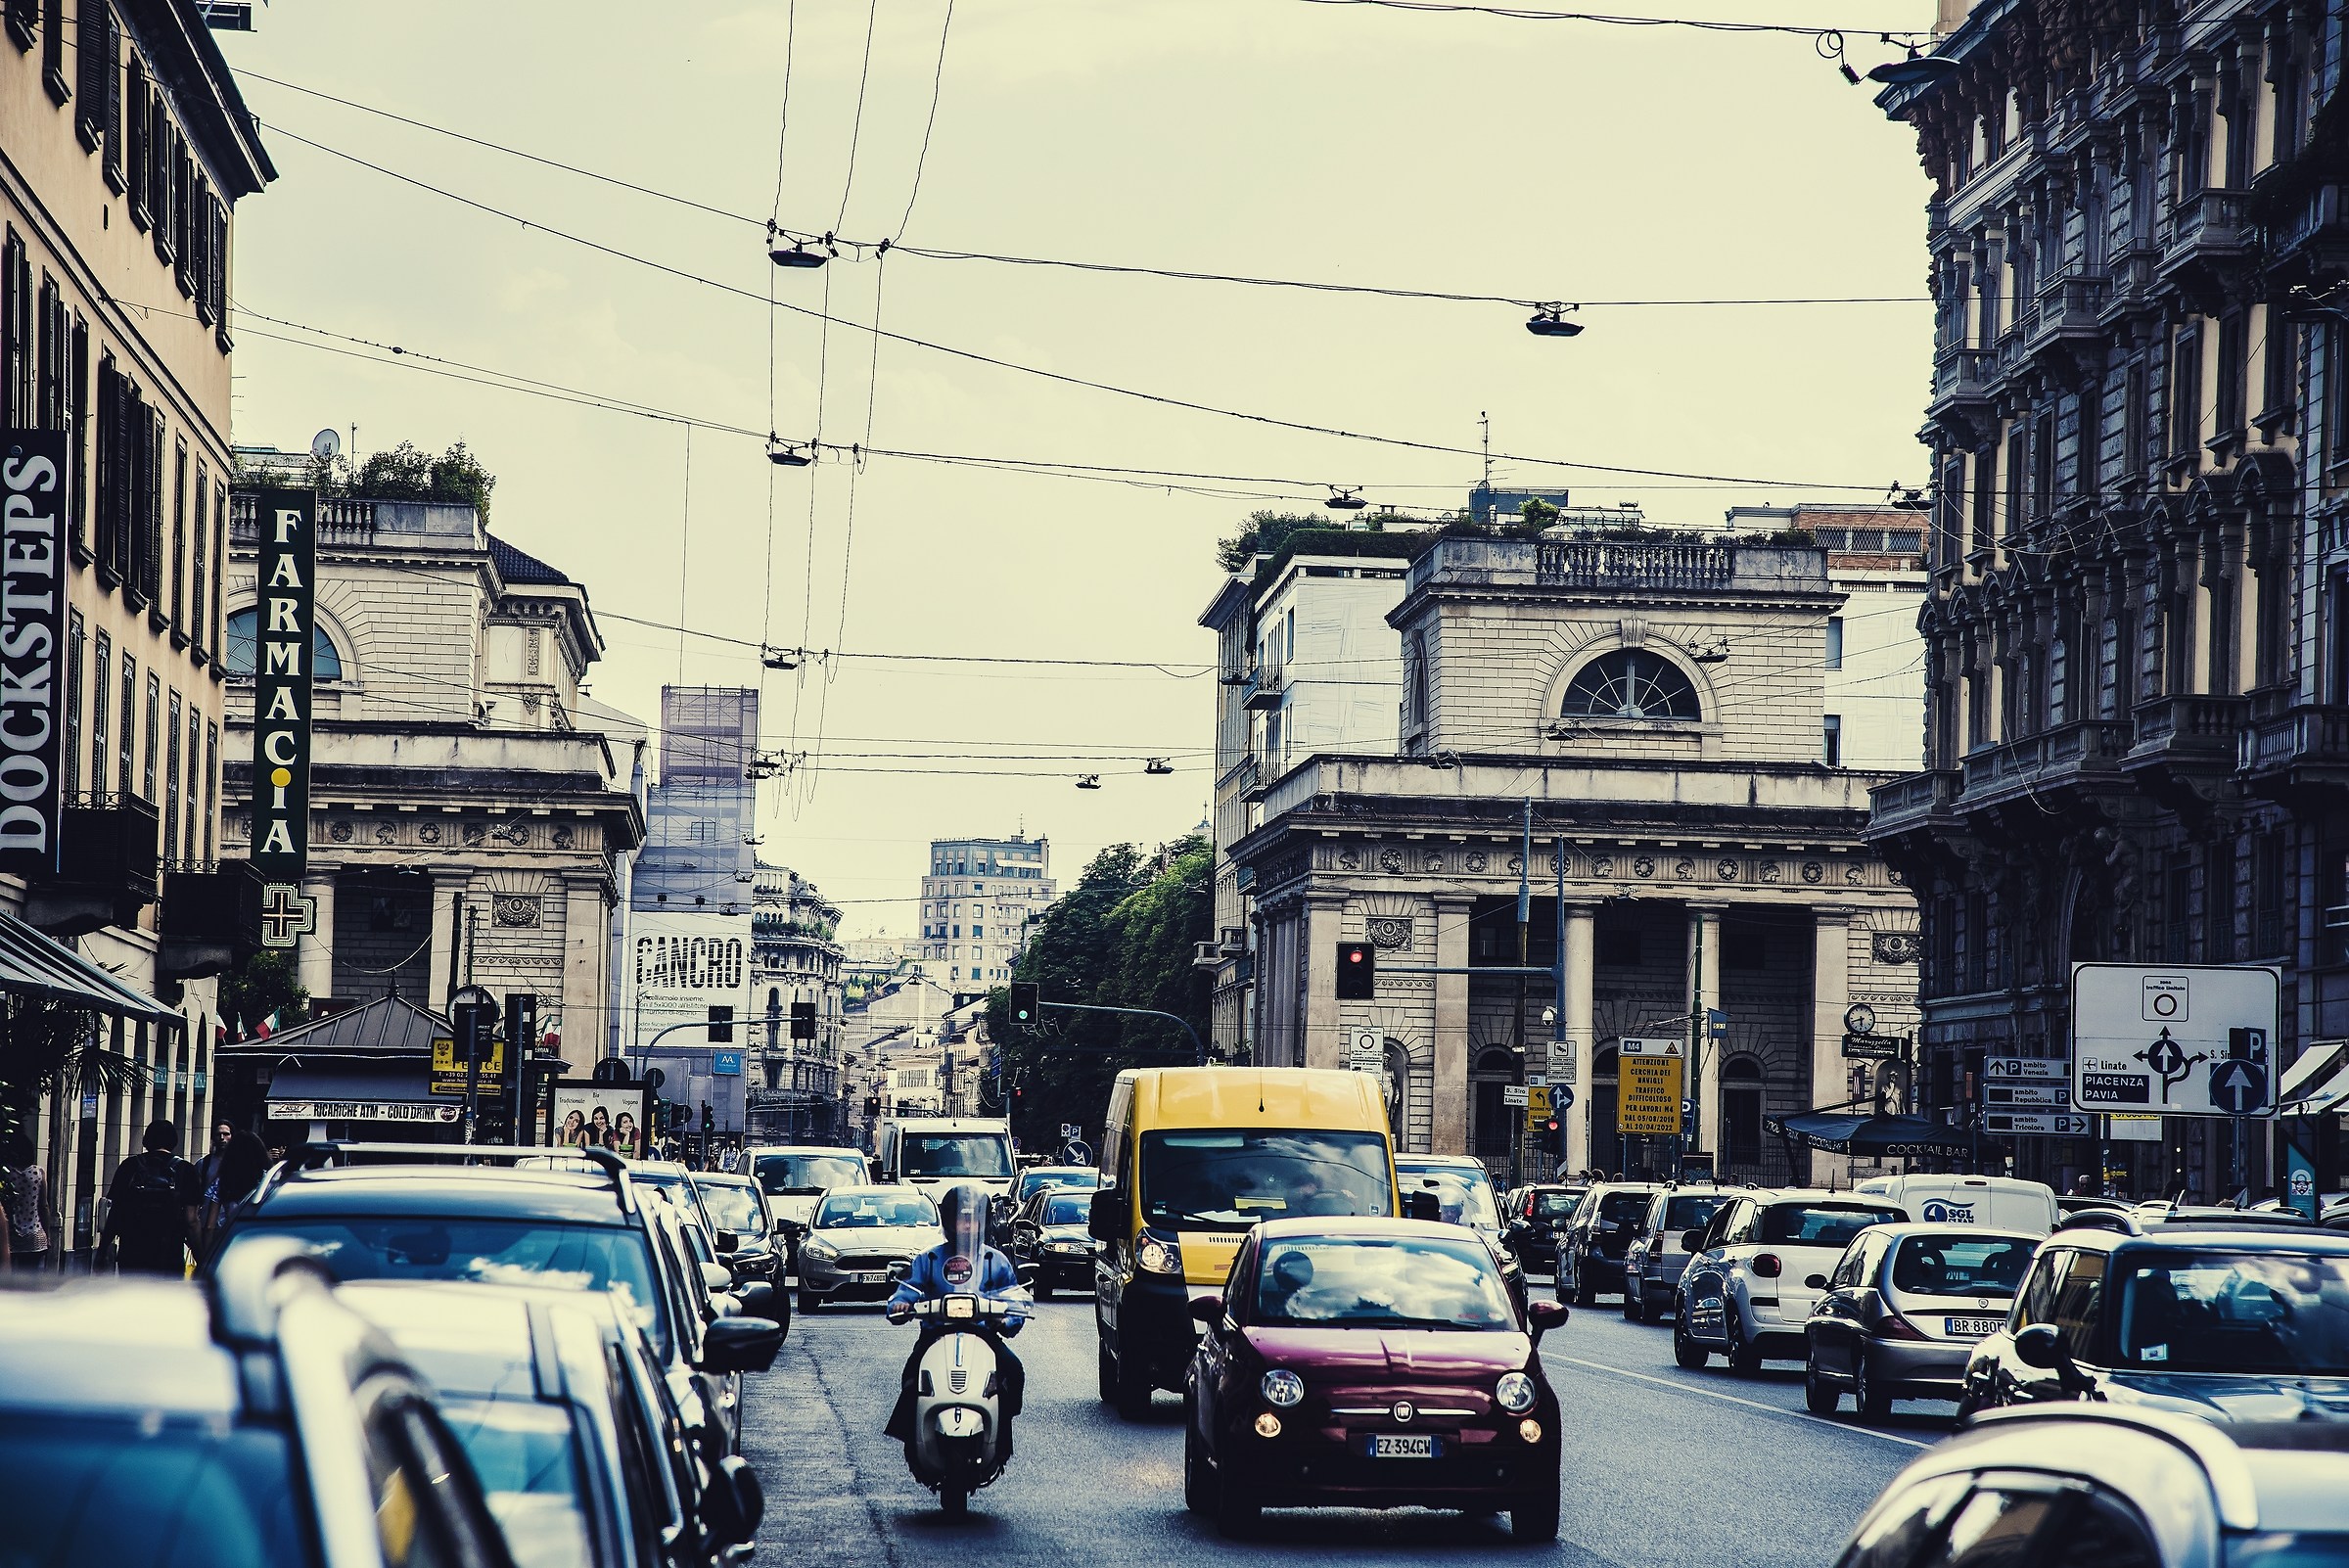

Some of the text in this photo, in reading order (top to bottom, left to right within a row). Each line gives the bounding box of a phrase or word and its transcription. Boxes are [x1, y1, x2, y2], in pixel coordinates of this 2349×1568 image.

[0, 455, 57, 854] DOCKSTEPS
[636, 937, 742, 989] CANCRO
[1627, 1042, 1640, 1051] M4
[1851, 1038, 1891, 1046] Maruzzella
[2249, 1032, 2262, 1060] P
[2210, 1050, 2231, 1060] S. Sir
[1632, 1058, 1670, 1067] ATTENZIONE
[2009, 1062, 2018, 1074] P
[2100, 1060, 2127, 1071] Linate
[2085, 1076, 2144, 1087] PIACENZA
[1628, 1094, 1672, 1103] DIFFICOLTOSO
[2058, 1091, 2067, 1102] P
[2085, 1089, 2119, 1100] PAVIA
[313, 1103, 358, 1118] RICARICHE
[359, 1105, 379, 1118] ATM
[387, 1105, 409, 1119] COLD
[2058, 1119, 2067, 1130] P
[1886, 1143, 1968, 1158] COCKTAIL BAR
[1948, 1209, 1974, 1219] SGL
